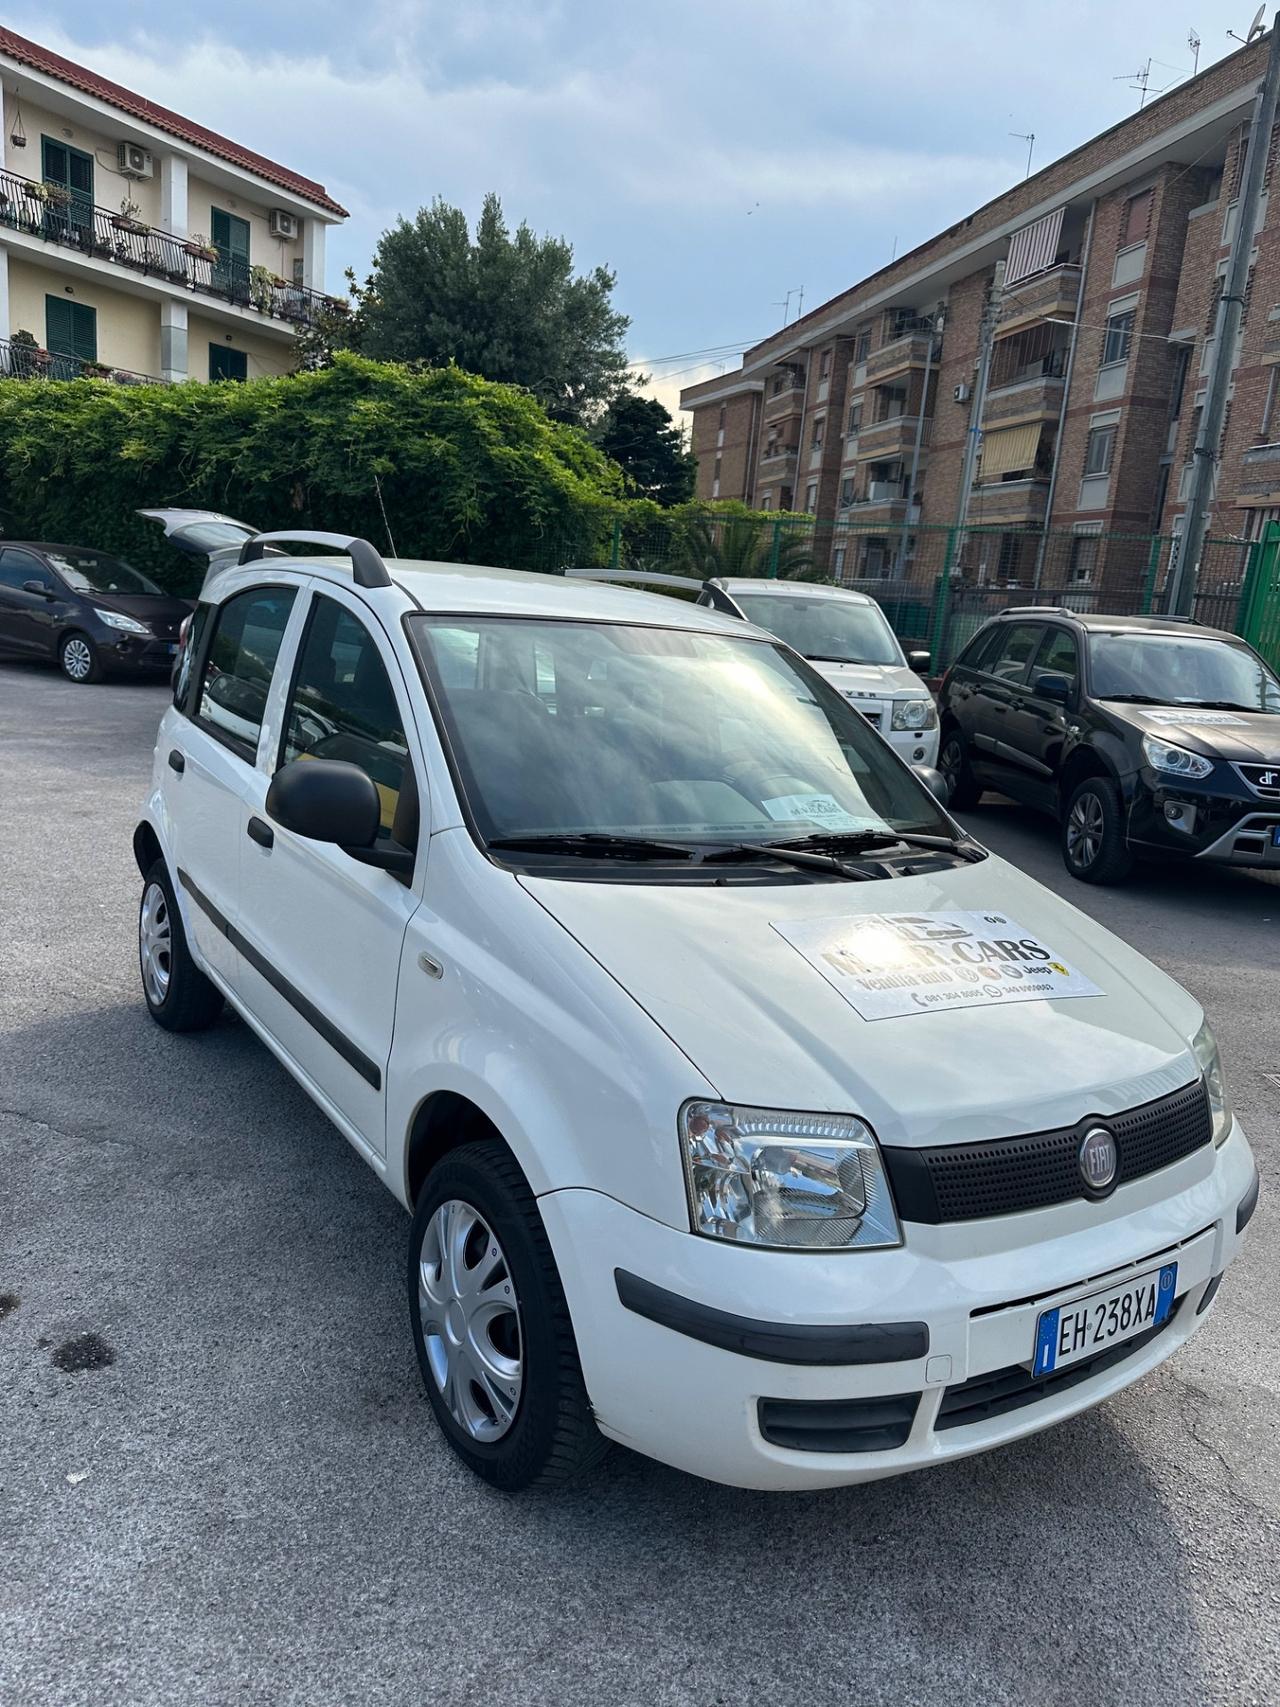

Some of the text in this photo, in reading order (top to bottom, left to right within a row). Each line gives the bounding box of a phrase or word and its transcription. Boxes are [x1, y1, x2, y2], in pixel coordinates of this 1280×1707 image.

[843, 690, 877, 698] VER
[918, 970, 953, 986] auto
[1023, 965, 1051, 976] Jeep
[1089, 1145, 1110, 1175] FIAT
[1059, 1309, 1087, 1356] EH
[1093, 1283, 1156, 1344] 238XA
